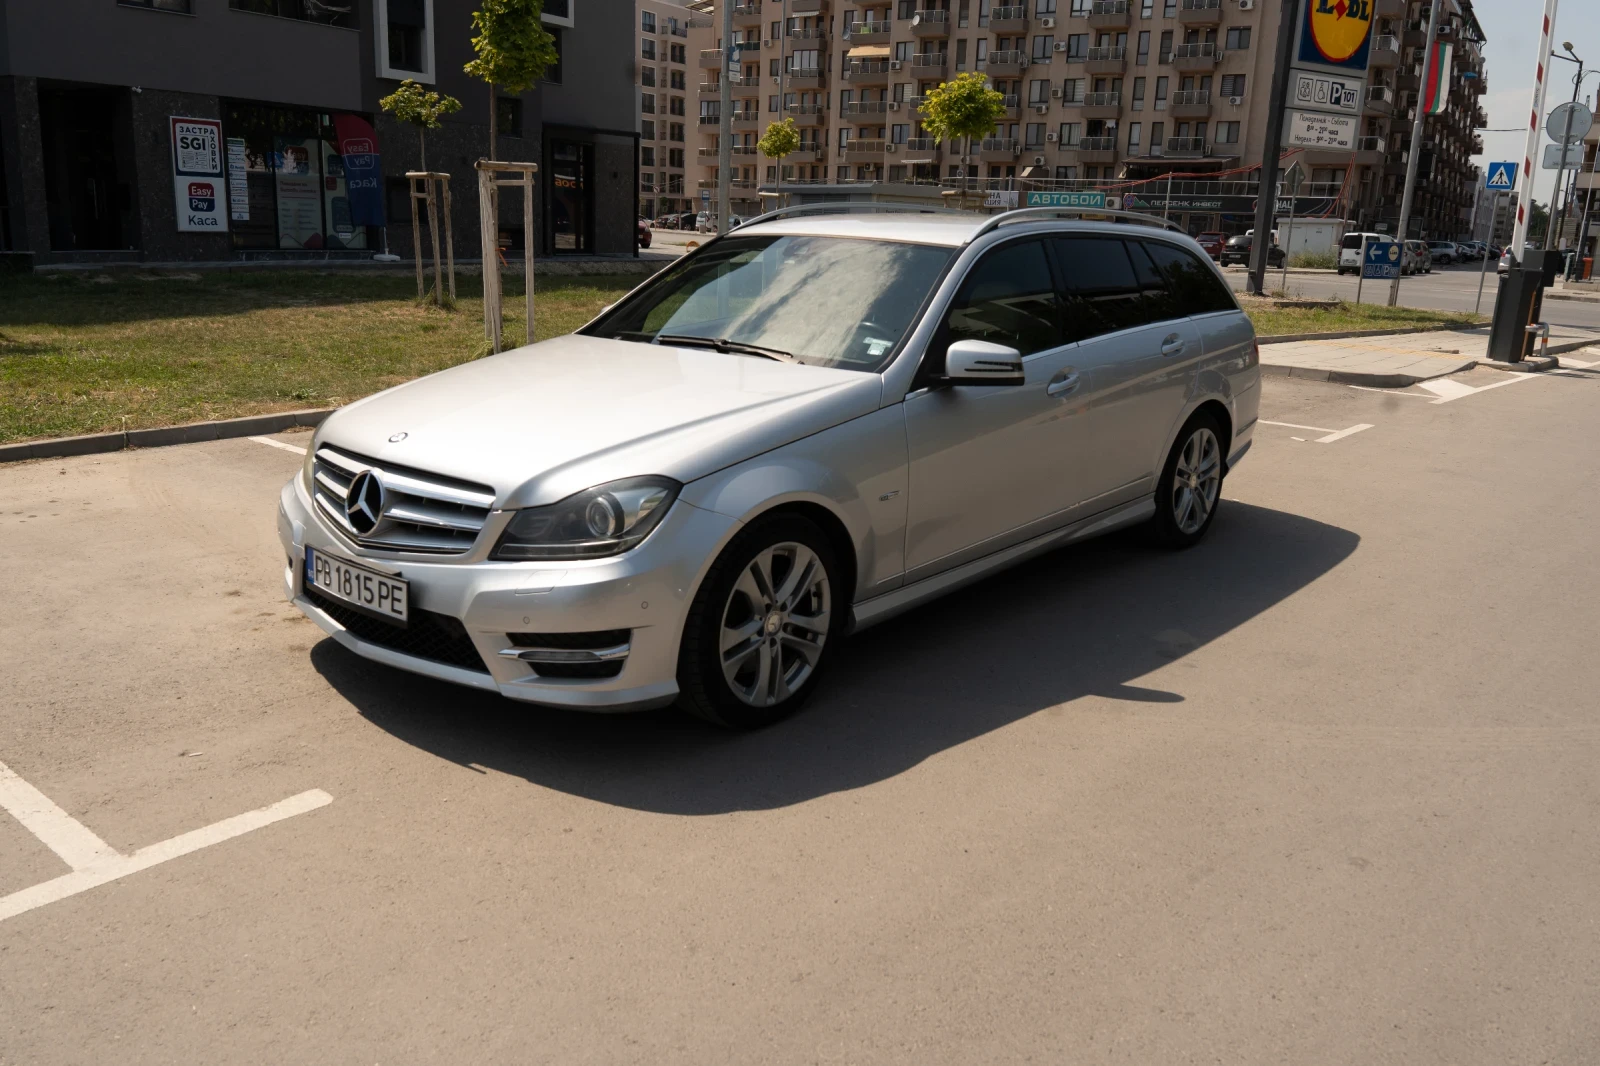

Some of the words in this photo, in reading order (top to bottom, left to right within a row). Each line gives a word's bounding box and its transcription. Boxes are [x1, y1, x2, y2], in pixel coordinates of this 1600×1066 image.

[1316, 0, 1369, 21] LIDL
[1343, 91, 1355, 103] 101
[180, 136, 206, 151] SGI
[1294, 135, 1312, 145] Неделя
[191, 186, 212, 197] Easy
[192, 199, 209, 210] Pay
[1031, 194, 1101, 206] АВТОБОИ
[188, 215, 218, 226] Каса
[315, 555, 332, 587] PB
[336, 565, 374, 604] 1815
[378, 580, 403, 616] PE
